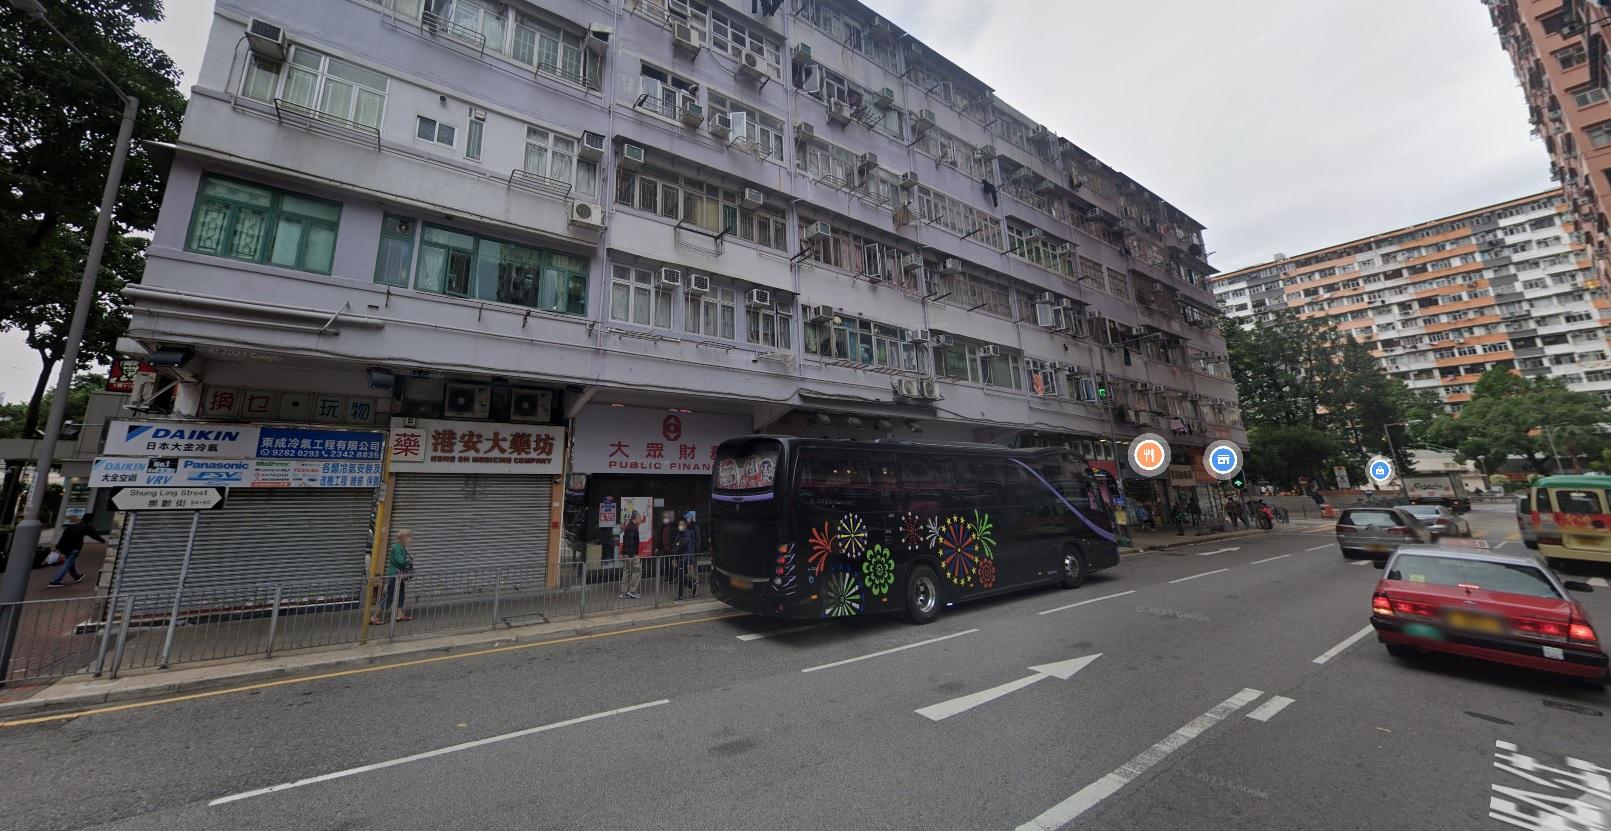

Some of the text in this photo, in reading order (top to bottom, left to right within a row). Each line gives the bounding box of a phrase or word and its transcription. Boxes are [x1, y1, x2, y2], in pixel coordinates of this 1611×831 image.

[152, 428, 240, 442] DAIKIN
[146, 441, 219, 453] 日本大金冷氣
[261, 437, 381, 452] 東成冷氣工程有限公司
[392, 432, 422, 456] 藥
[431, 429, 556, 456] 港安大藥坊
[271, 449, 380, 459] 9282 0293 2342 8835
[184, 460, 249, 470] Panasonic
[513, 457, 553, 465] COMPANY
[608, 461, 711, 471] PUBLIC FINAN
[104, 462, 146, 471] DAIKIN
[322, 463, 380, 474] 各類冷氣安裝及
[146, 475, 173, 484] VRV
[129, 489, 158, 497] Shung
[159, 489, 178, 497] Ling
